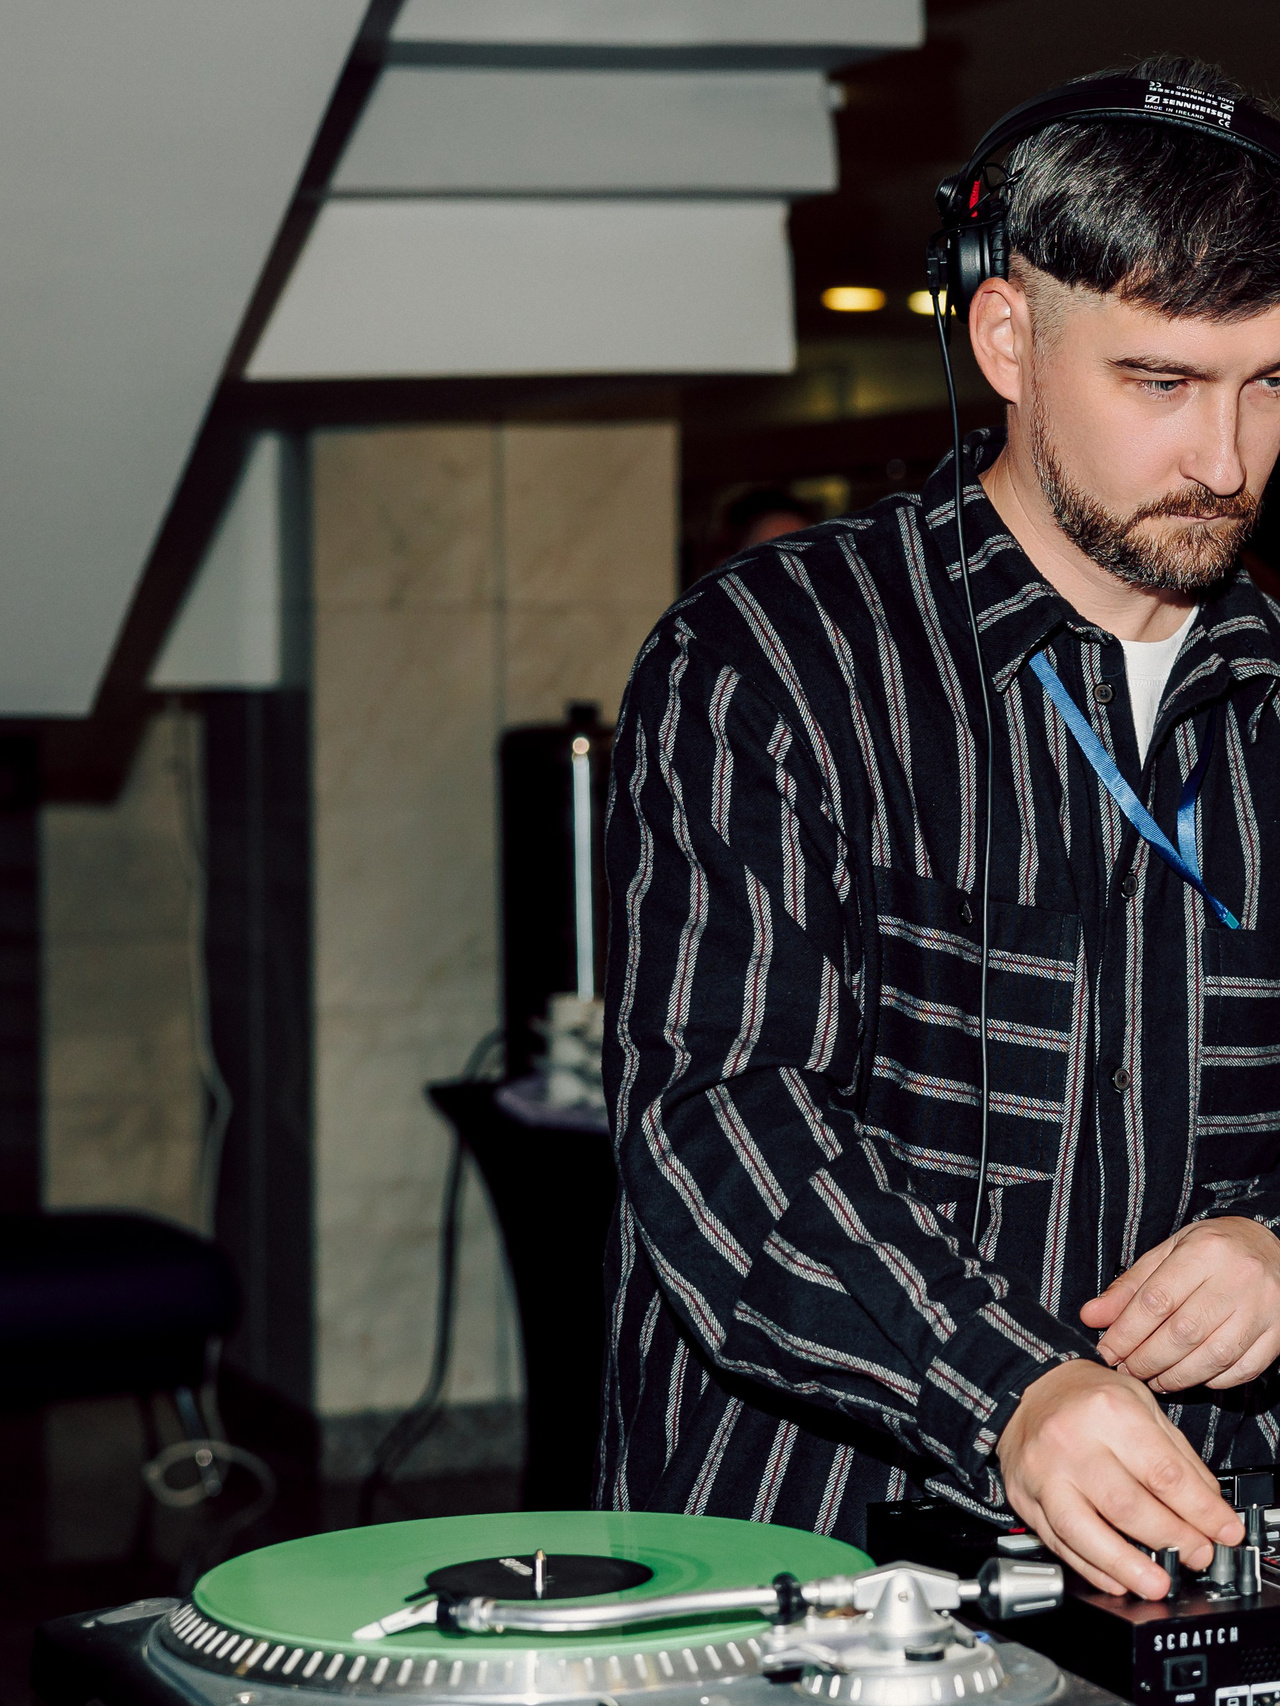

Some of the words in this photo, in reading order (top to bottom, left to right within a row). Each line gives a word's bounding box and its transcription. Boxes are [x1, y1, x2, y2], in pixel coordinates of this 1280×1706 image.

[1162, 98, 1232, 121] SENNHEISER
[1175, 109, 1205, 120] IRELAND
[1154, 1626, 1239, 1652] SCRATCH
